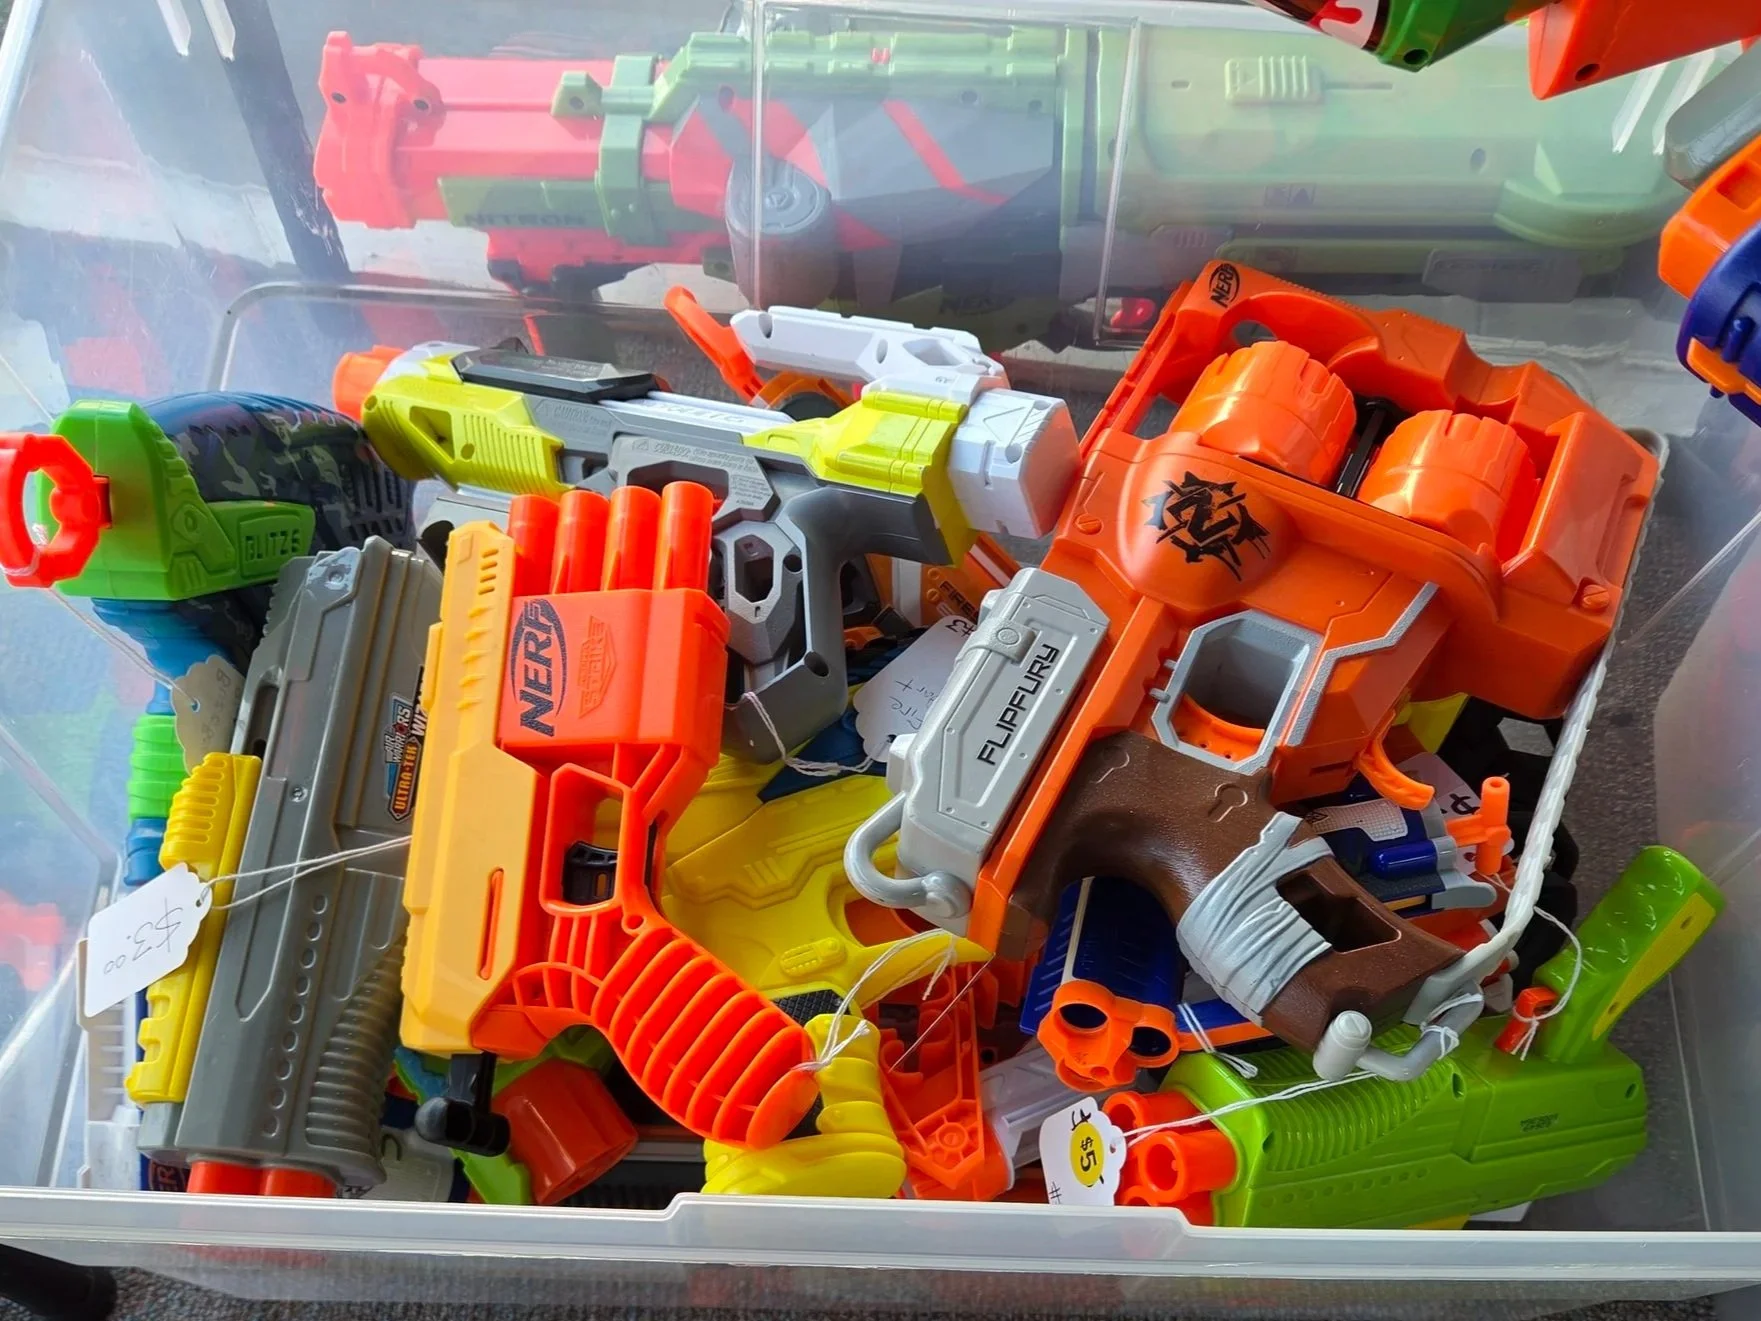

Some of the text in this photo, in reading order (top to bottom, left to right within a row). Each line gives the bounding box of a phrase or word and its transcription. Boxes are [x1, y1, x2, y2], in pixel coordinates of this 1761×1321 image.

[464, 212, 586, 226] NITRON
[1210, 265, 1234, 308] NERF
[519, 597, 555, 737] NERF
[977, 643, 1060, 766] FLIPFURY
[384, 734, 395, 756] AIR
[1080, 1136, 1097, 1172] $5
